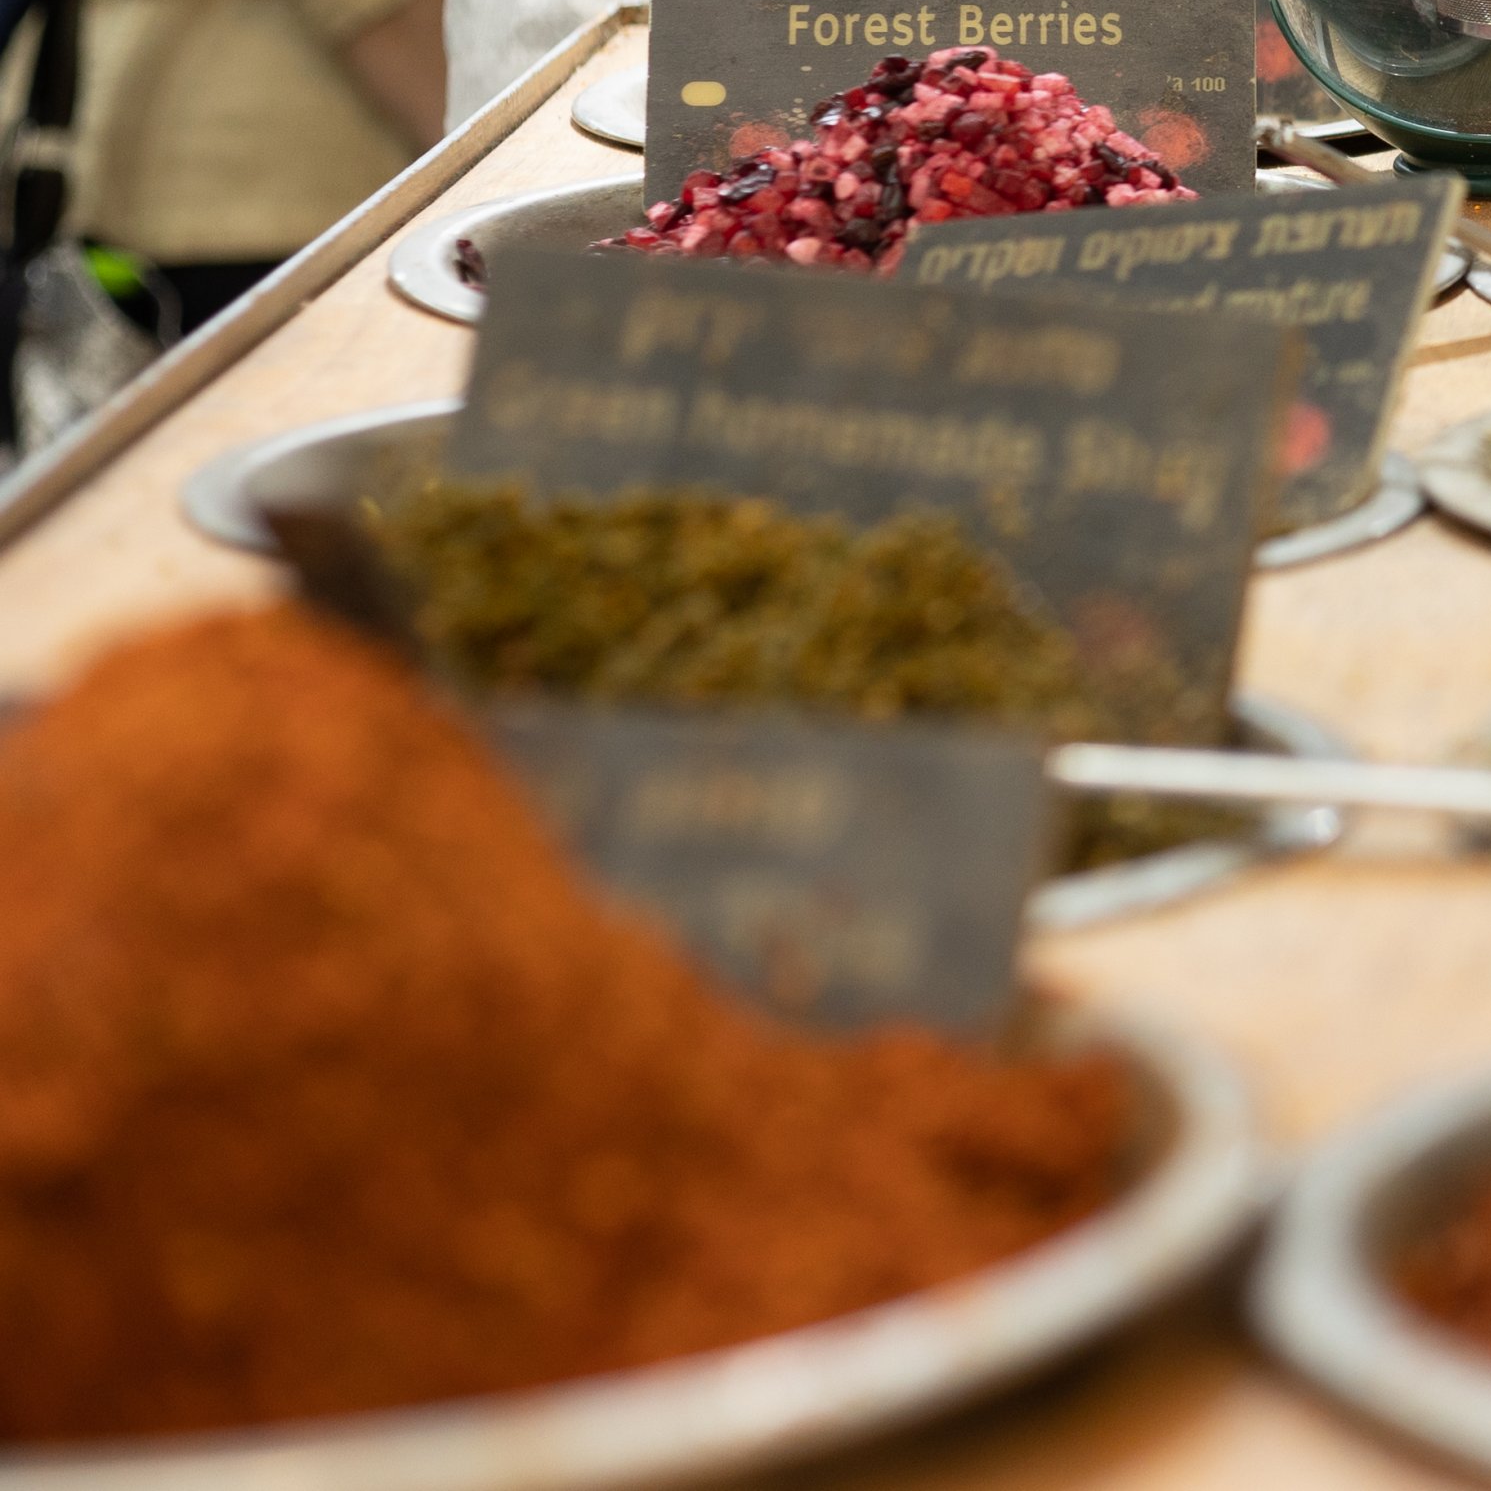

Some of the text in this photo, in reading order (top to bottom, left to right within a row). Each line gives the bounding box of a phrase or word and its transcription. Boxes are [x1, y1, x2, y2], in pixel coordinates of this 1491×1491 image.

[787, 2, 1124, 47] Forest Berries
[1187, 76, 1227, 93] 100
